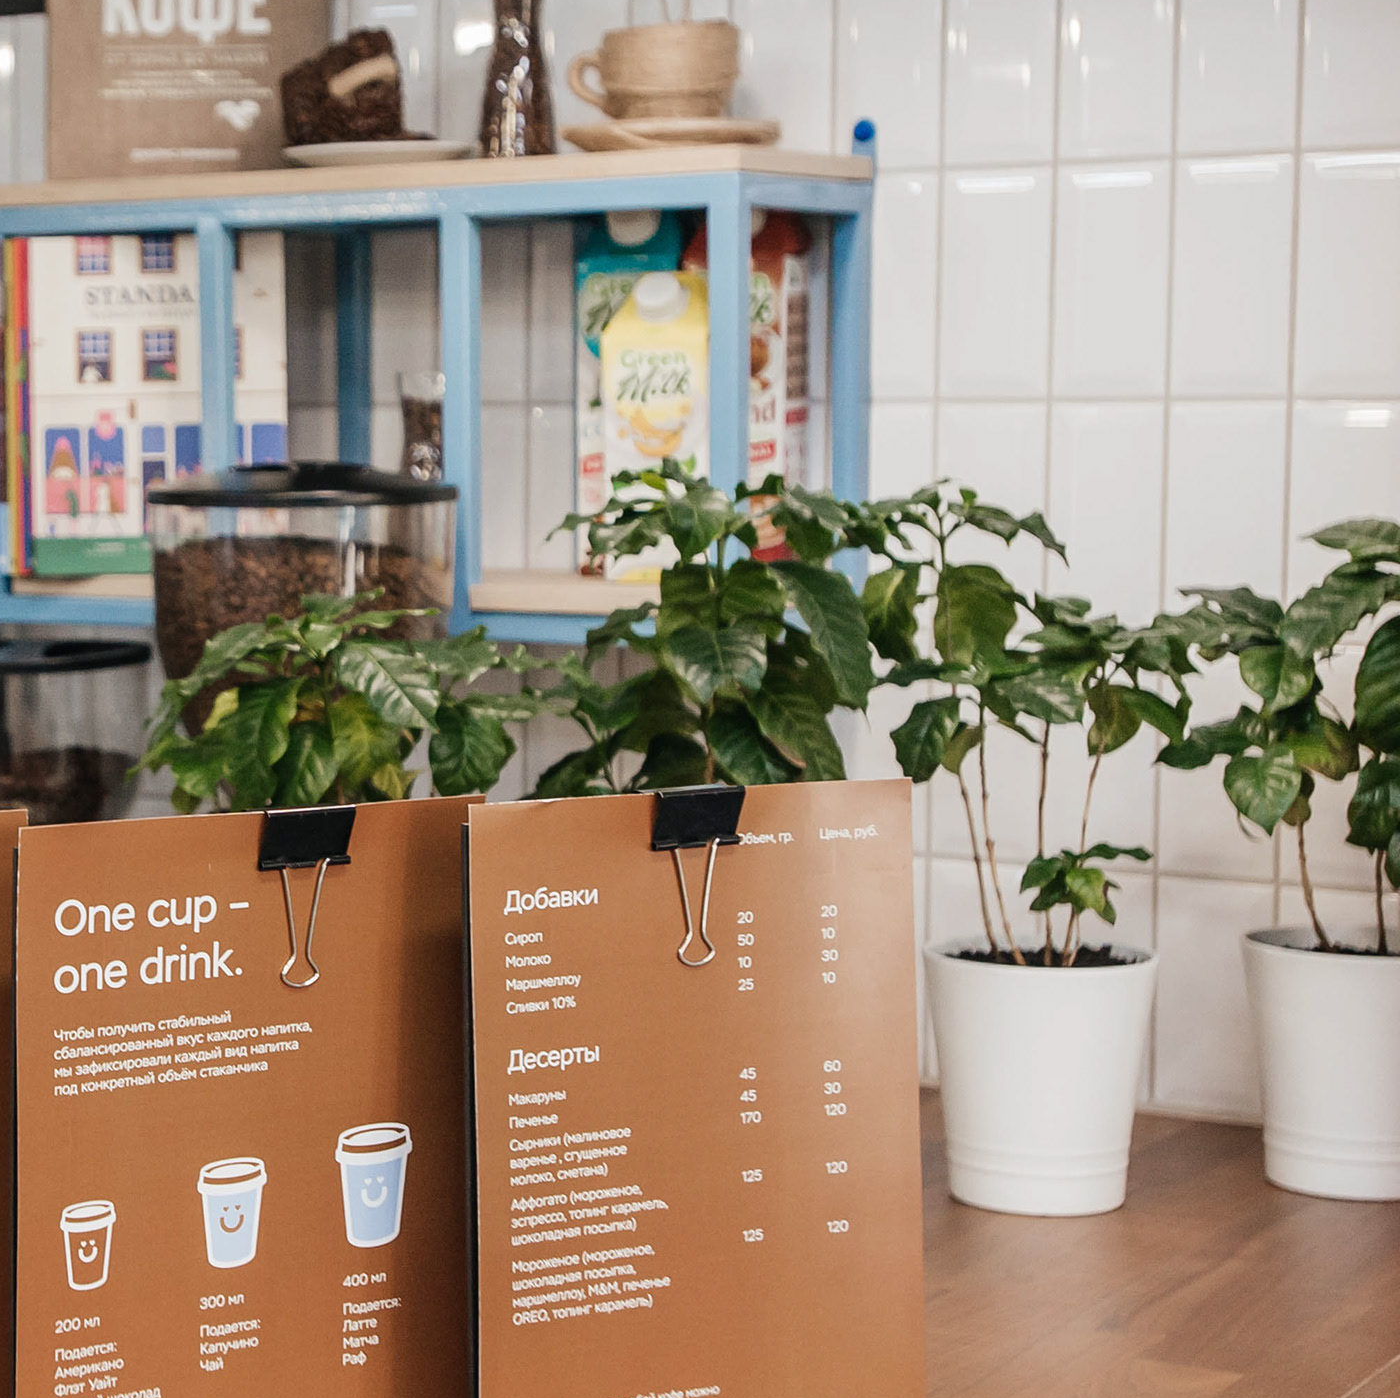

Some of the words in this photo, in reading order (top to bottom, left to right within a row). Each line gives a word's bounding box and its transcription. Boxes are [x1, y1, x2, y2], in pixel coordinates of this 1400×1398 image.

[85, 282, 195, 306] STANDA
[778, 833, 794, 844] гр.
[819, 828, 851, 840] Цена,
[854, 825, 878, 840] руб.
[504, 886, 599, 916] Добавки
[55, 899, 134, 936] One
[147, 895, 218, 933] cup
[505, 931, 543, 946] Сироп
[54, 956, 127, 994] one
[140, 941, 243, 985] drink.
[505, 952, 551, 968] Молоко
[506, 973, 581, 992] Маршмеллоу
[506, 998, 549, 1014] Сливки
[552, 996, 576, 1009] 10%
[54, 1026, 94, 1042] Чтобы
[98, 1020, 155, 1039] получить
[158, 1012, 231, 1032] стабильный
[54, 1034, 173, 1061] сбалансированный
[177, 1032, 204, 1046] вкус
[207, 1025, 258, 1044] каждого
[261, 1021, 312, 1037] напитка,
[54, 1066, 72, 1078] мы
[75, 1052, 171, 1077] зафиксировали
[174, 1047, 222, 1067] каждый
[225, 1046, 247, 1058] вид
[250, 1039, 299, 1056] напитка
[507, 1044, 600, 1075] Десерты
[823, 1060, 841, 1073] 60
[54, 1083, 78, 1097] под
[81, 1073, 155, 1094] конкретный
[158, 1068, 196, 1084] объём
[200, 1060, 268, 1080] стаканчика
[740, 1068, 757, 1080] 45
[509, 1089, 566, 1106] Макаруны
[510, 1112, 558, 1129] Печенье
[510, 1136, 560, 1152] Сырники
[564, 1126, 631, 1147] (малиновое
[510, 1171, 555, 1187] молоко,
[558, 1163, 608, 1182] сметана)
[742, 1169, 762, 1182] 125
[826, 1161, 847, 1174] 120
[343, 1272, 368, 1288] 400
[371, 1271, 386, 1283] мл
[200, 1295, 225, 1310] 300
[228, 1293, 244, 1305] мл
[343, 1297, 401, 1315] Подается:
[55, 1318, 81, 1333] 200
[84, 1316, 100, 1329] мл
[200, 1319, 261, 1338] Подается:
[343, 1317, 377, 1332] Латте
[200, 1336, 259, 1355] Капучино
[343, 1333, 379, 1349] Матча
[55, 1342, 117, 1362] Подается:
[343, 1352, 366, 1367] Раф
[54, 1357, 124, 1379] Американо
[200, 1358, 224, 1372] Чай
[54, 1379, 86, 1396] Флэт
[88, 1376, 118, 1392] Уайт
